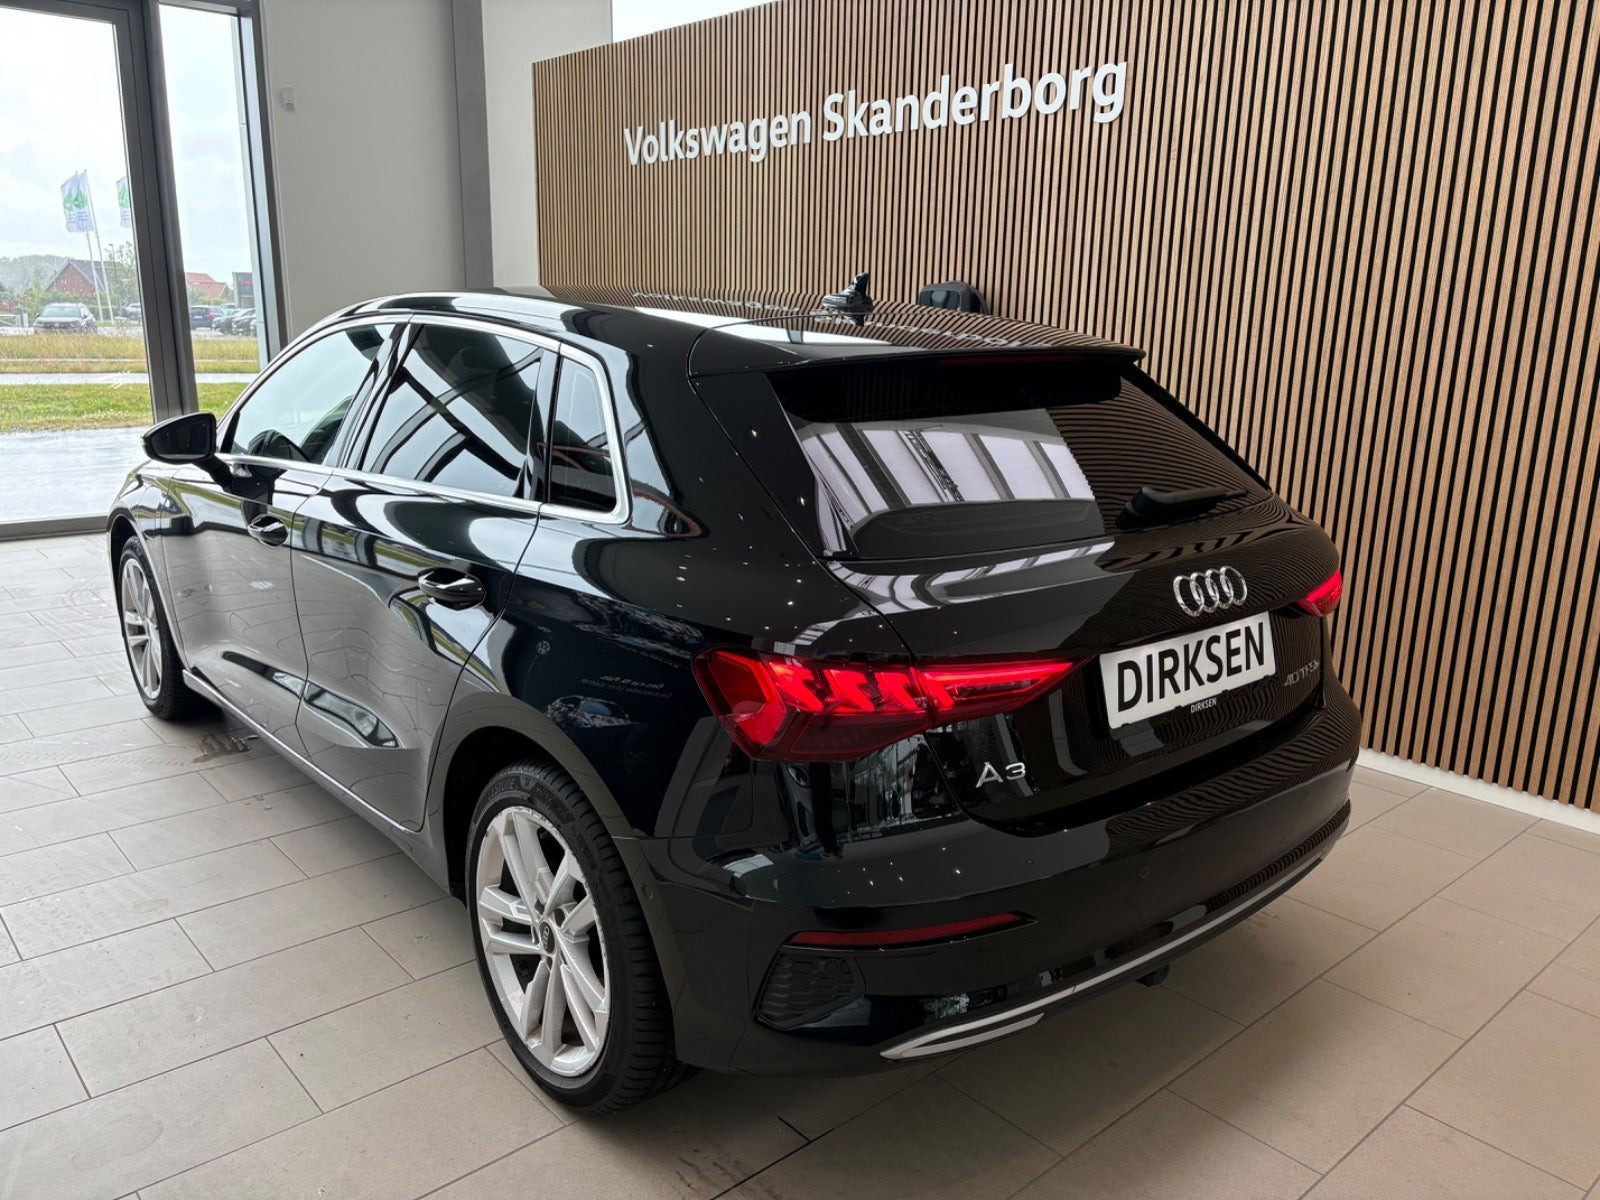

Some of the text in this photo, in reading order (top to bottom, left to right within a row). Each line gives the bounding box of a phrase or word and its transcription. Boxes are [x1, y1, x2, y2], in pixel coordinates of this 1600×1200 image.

[623, 61, 1127, 166] Volkswagen Skanderborg
[1117, 621, 1266, 713] DIRKSEN
[1190, 696, 1217, 714] DIRKSEN
[975, 761, 1026, 789] A3
